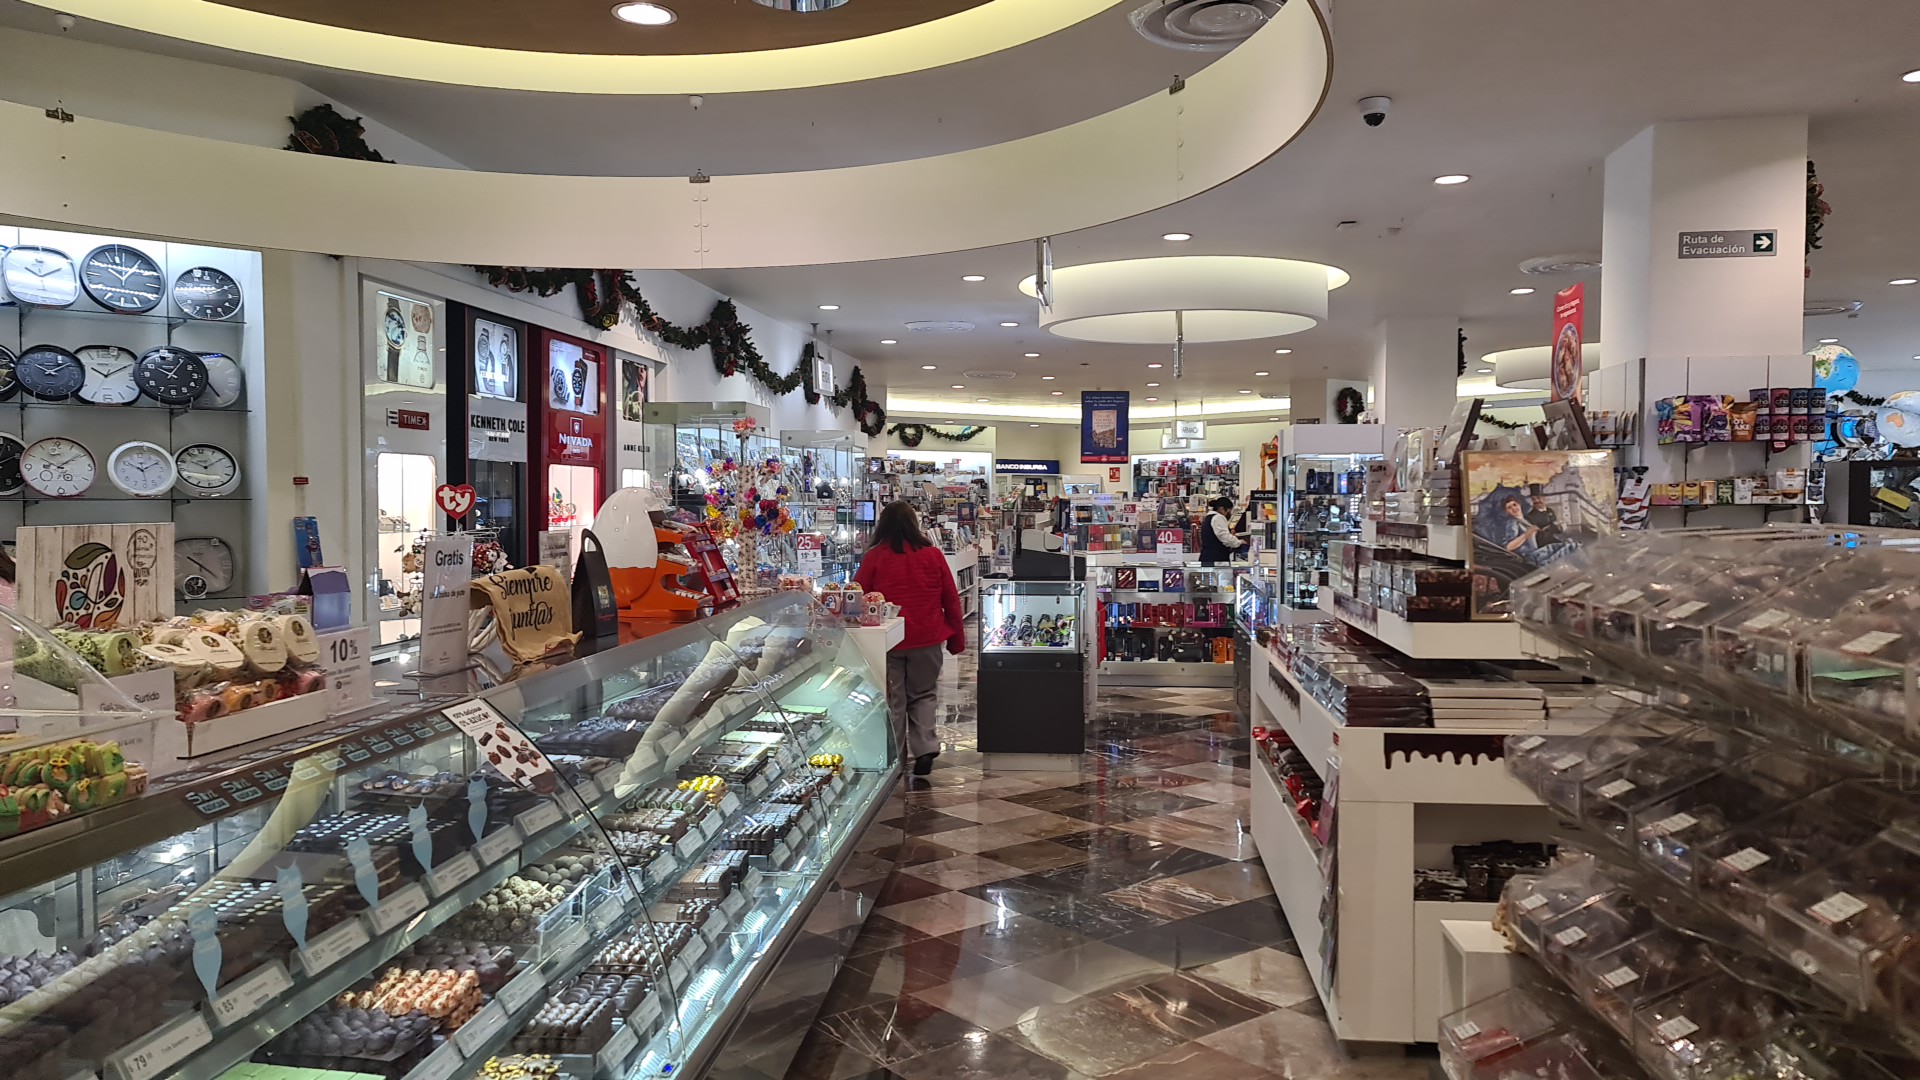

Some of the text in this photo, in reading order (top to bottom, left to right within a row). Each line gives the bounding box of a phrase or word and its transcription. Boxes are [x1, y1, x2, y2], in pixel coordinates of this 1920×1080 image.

[1683, 234, 1724, 244] Ruta de
[1683, 244, 1745, 255] Evacuación
[402, 414, 427, 426] TIMEX
[470, 414, 526, 433] KENNETH COLE
[559, 431, 593, 448] NIVADA
[438, 486, 471, 513] ty
[435, 550, 464, 567] Gratis
[489, 573, 553, 604] Siempre
[134, 691, 160, 704] Surtido
